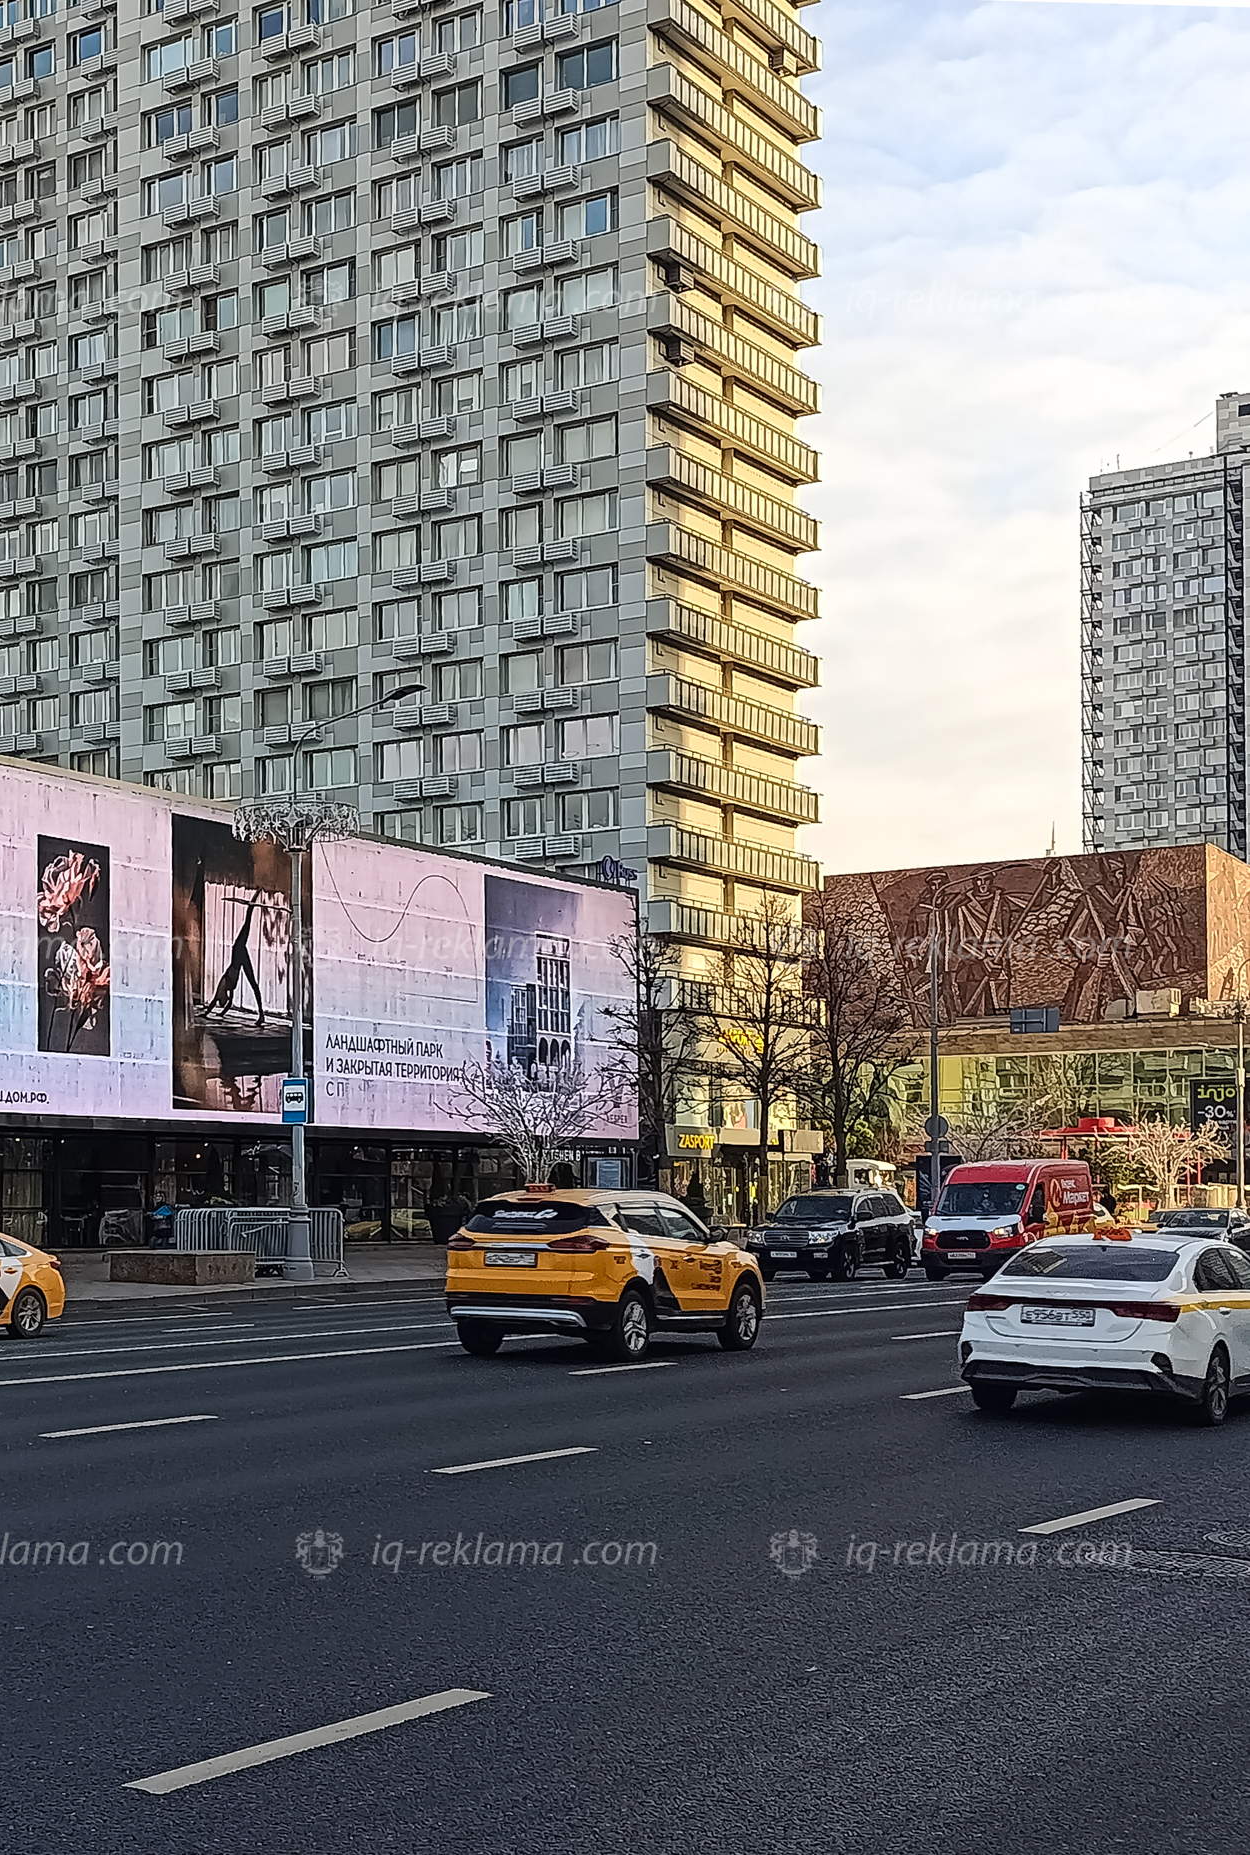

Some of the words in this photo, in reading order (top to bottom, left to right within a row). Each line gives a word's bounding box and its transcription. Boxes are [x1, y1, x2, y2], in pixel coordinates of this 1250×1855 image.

[325, 1033, 415, 1056] ЛАНДШАФТНЫЙ
[416, 1041, 444, 1059] ПАРК
[325, 1057, 334, 1073] И
[336, 1058, 393, 1077] ЗАКРЫТАЯ
[677, 1134, 716, 1150] ZASPORT
